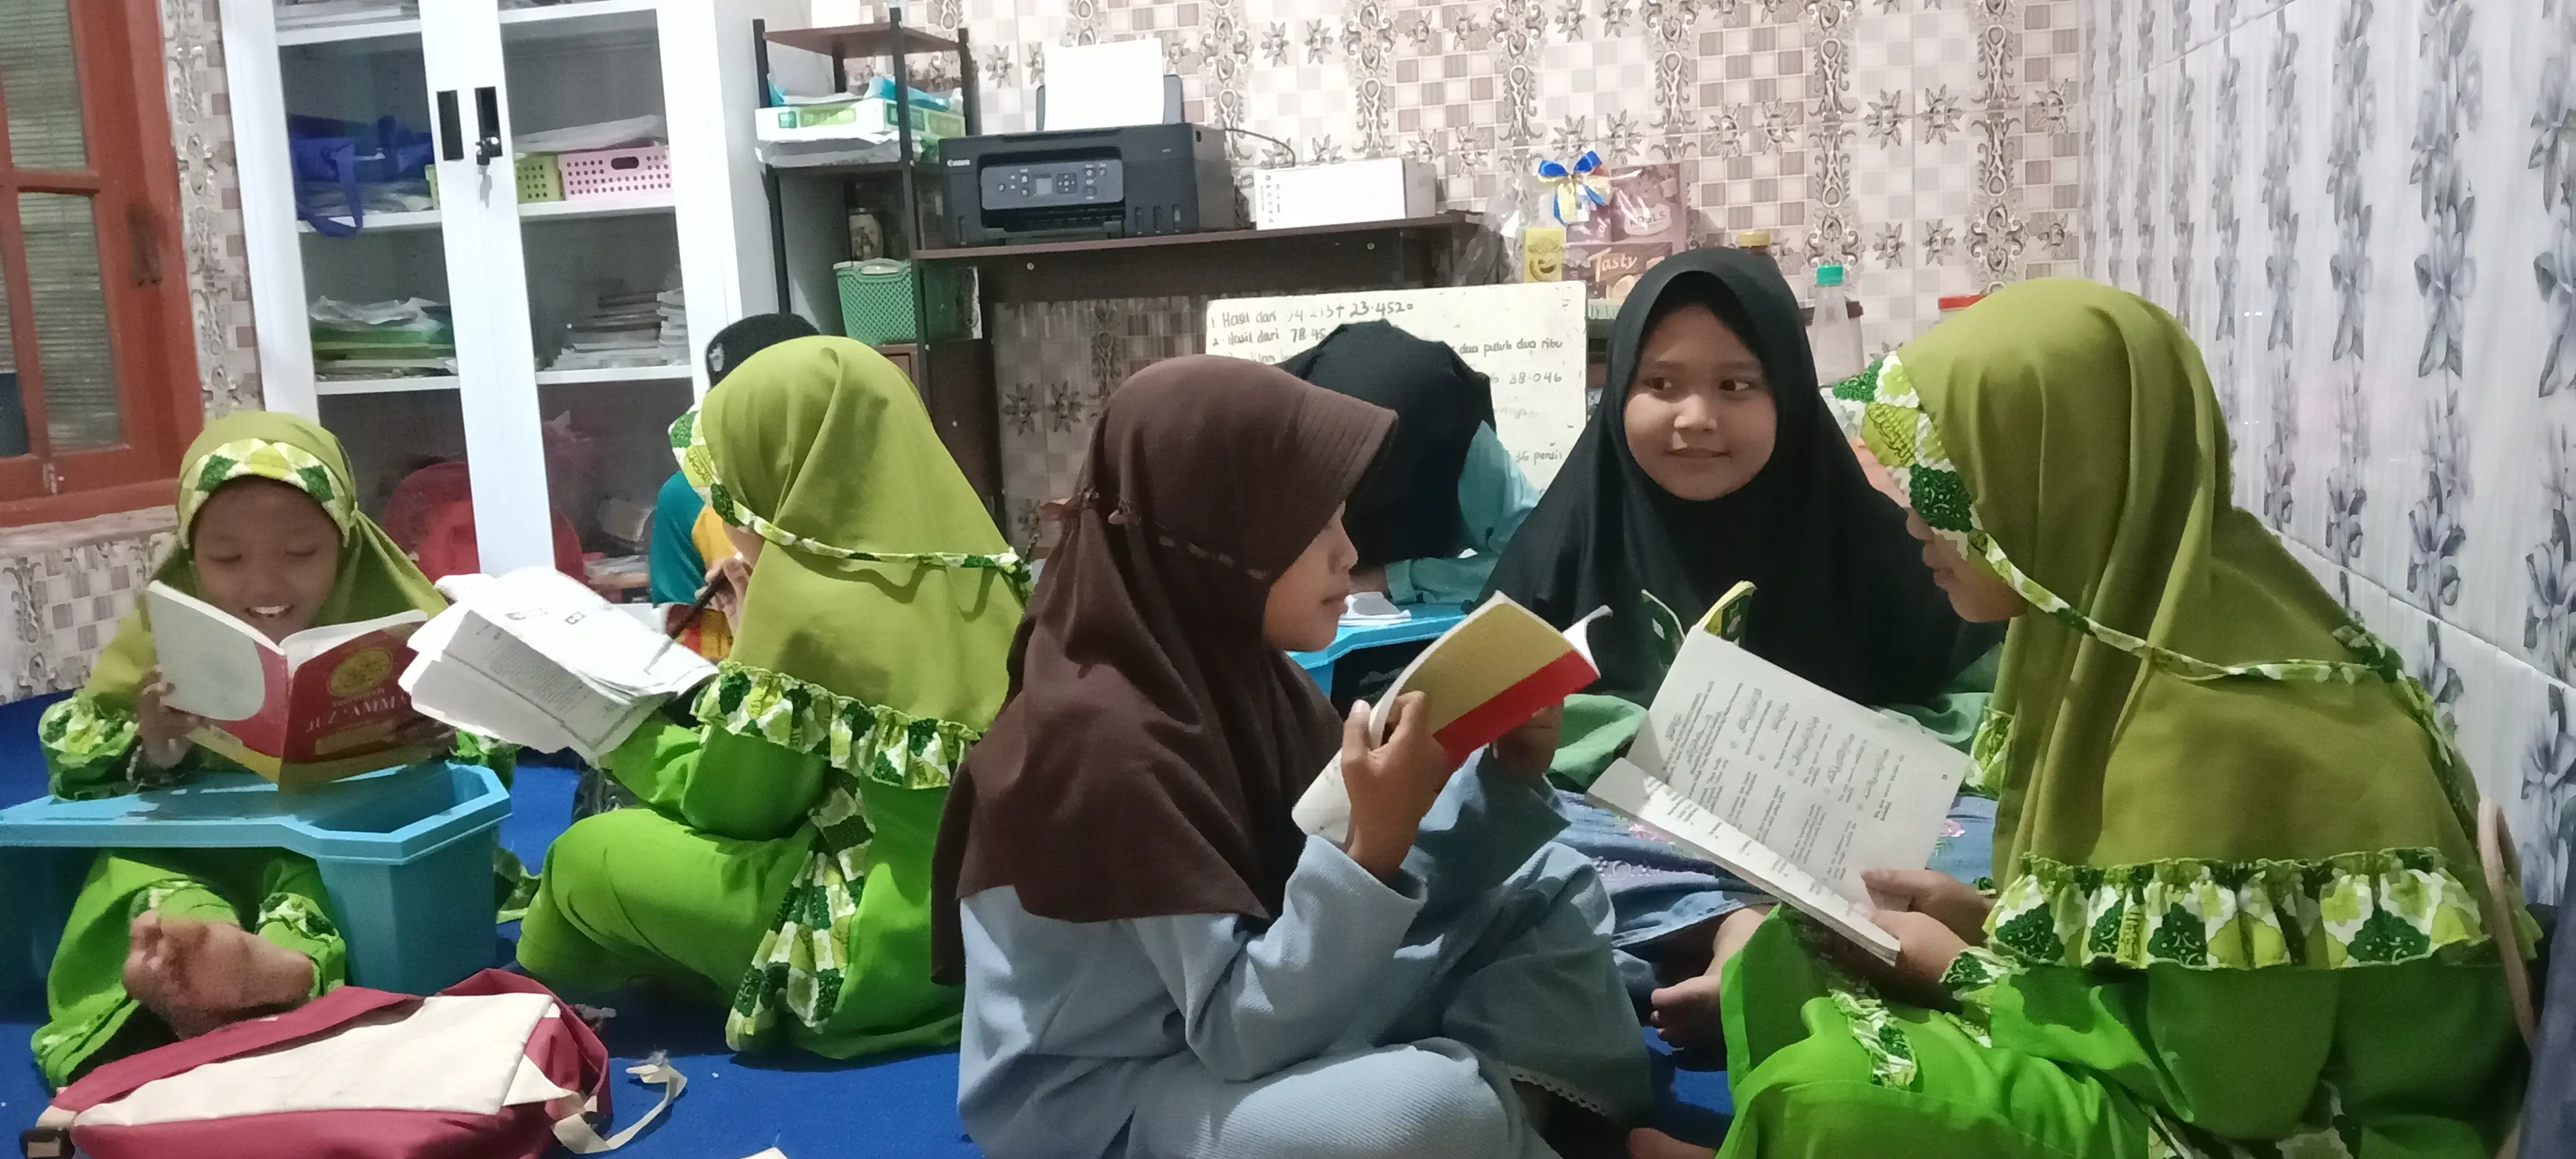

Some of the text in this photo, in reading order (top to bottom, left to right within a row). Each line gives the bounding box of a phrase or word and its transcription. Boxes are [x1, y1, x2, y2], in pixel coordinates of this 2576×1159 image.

[1587, 248, 1638, 282] Tasty
[1222, 312, 1250, 328] Hasil
[1256, 311, 1277, 323] dari
[1228, 332, 1253, 345] Hasil
[1257, 328, 1279, 343] dari
[1459, 338, 1563, 357] dua puluh dua ribu
